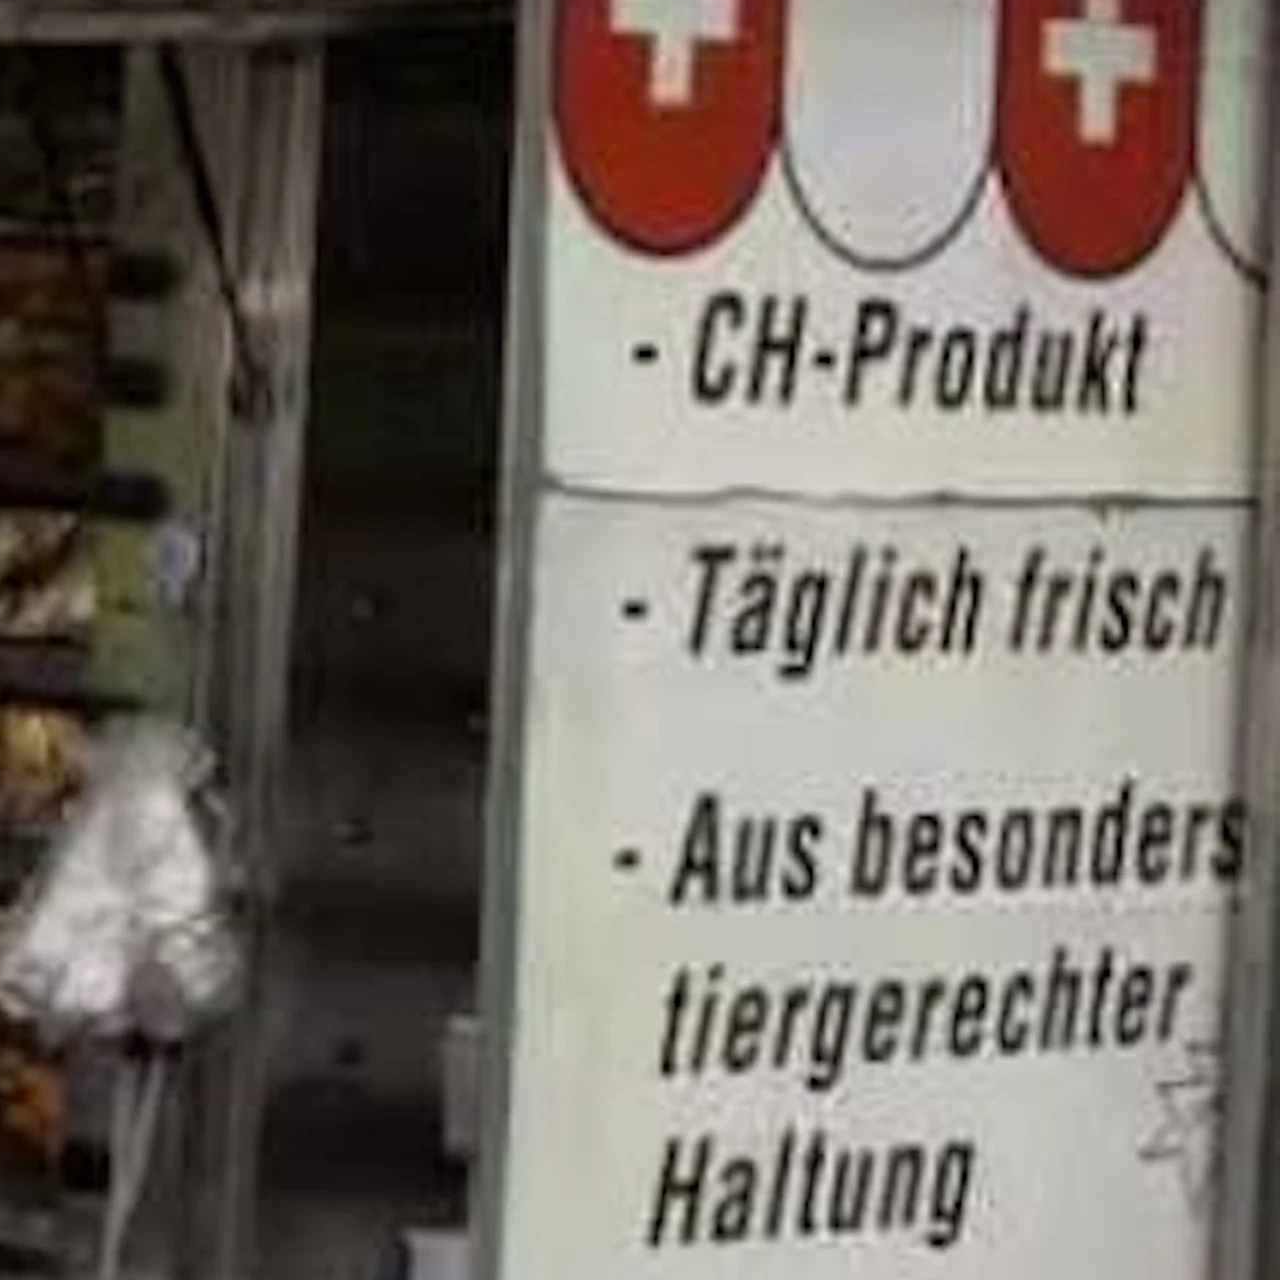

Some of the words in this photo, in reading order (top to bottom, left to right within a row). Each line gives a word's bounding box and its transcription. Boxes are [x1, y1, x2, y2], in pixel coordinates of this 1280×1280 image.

[690, 289, 1148, 417] CH-Produkt
[687, 544, 986, 682] Täglich
[1007, 546, 1230, 656] frisch
[667, 791, 824, 908] Aus
[849, 776, 1248, 898] besonders
[658, 944, 1194, 1092] tiergerechter
[645, 1128, 977, 1252] Haltung
